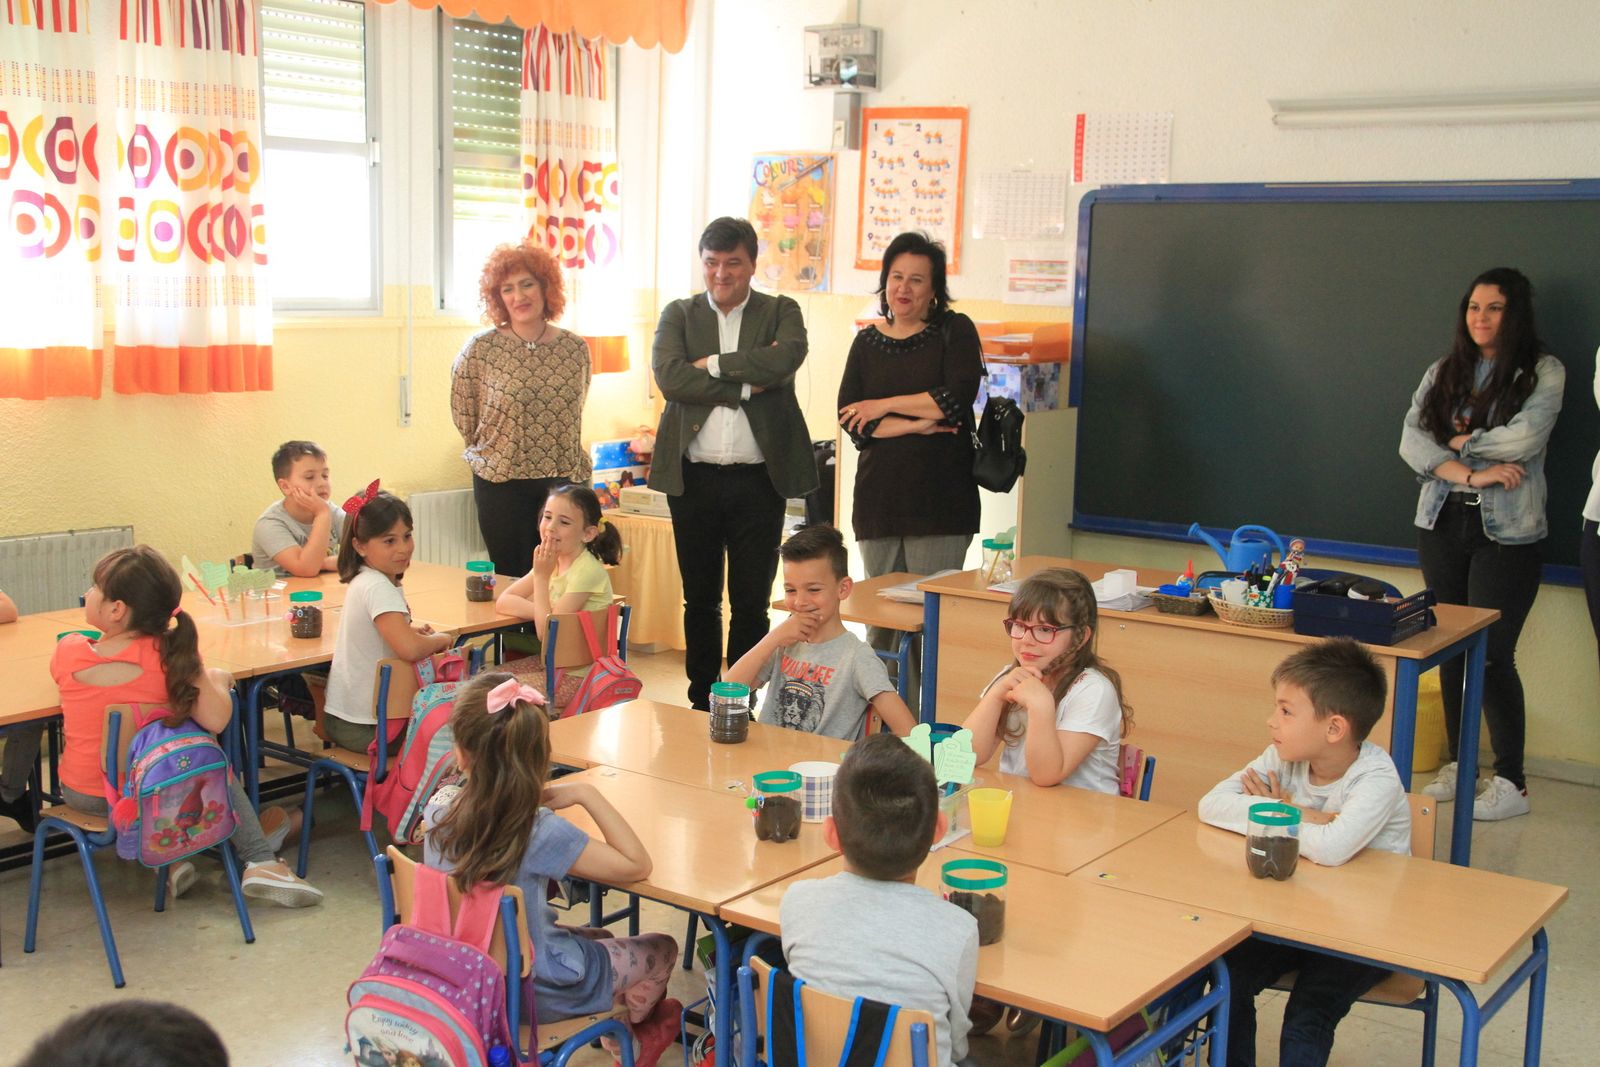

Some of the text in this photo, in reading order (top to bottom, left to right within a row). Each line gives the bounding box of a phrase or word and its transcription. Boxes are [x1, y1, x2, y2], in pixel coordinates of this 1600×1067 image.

[915, 123, 921, 132] 2
[871, 150, 877, 159] 3
[913, 150, 920, 159] 4
[870, 178, 875, 187] 5
[912, 179, 917, 187] 6
[869, 206, 875, 214] 7
[910, 207, 916, 215] 8
[868, 232, 873, 240] 9
